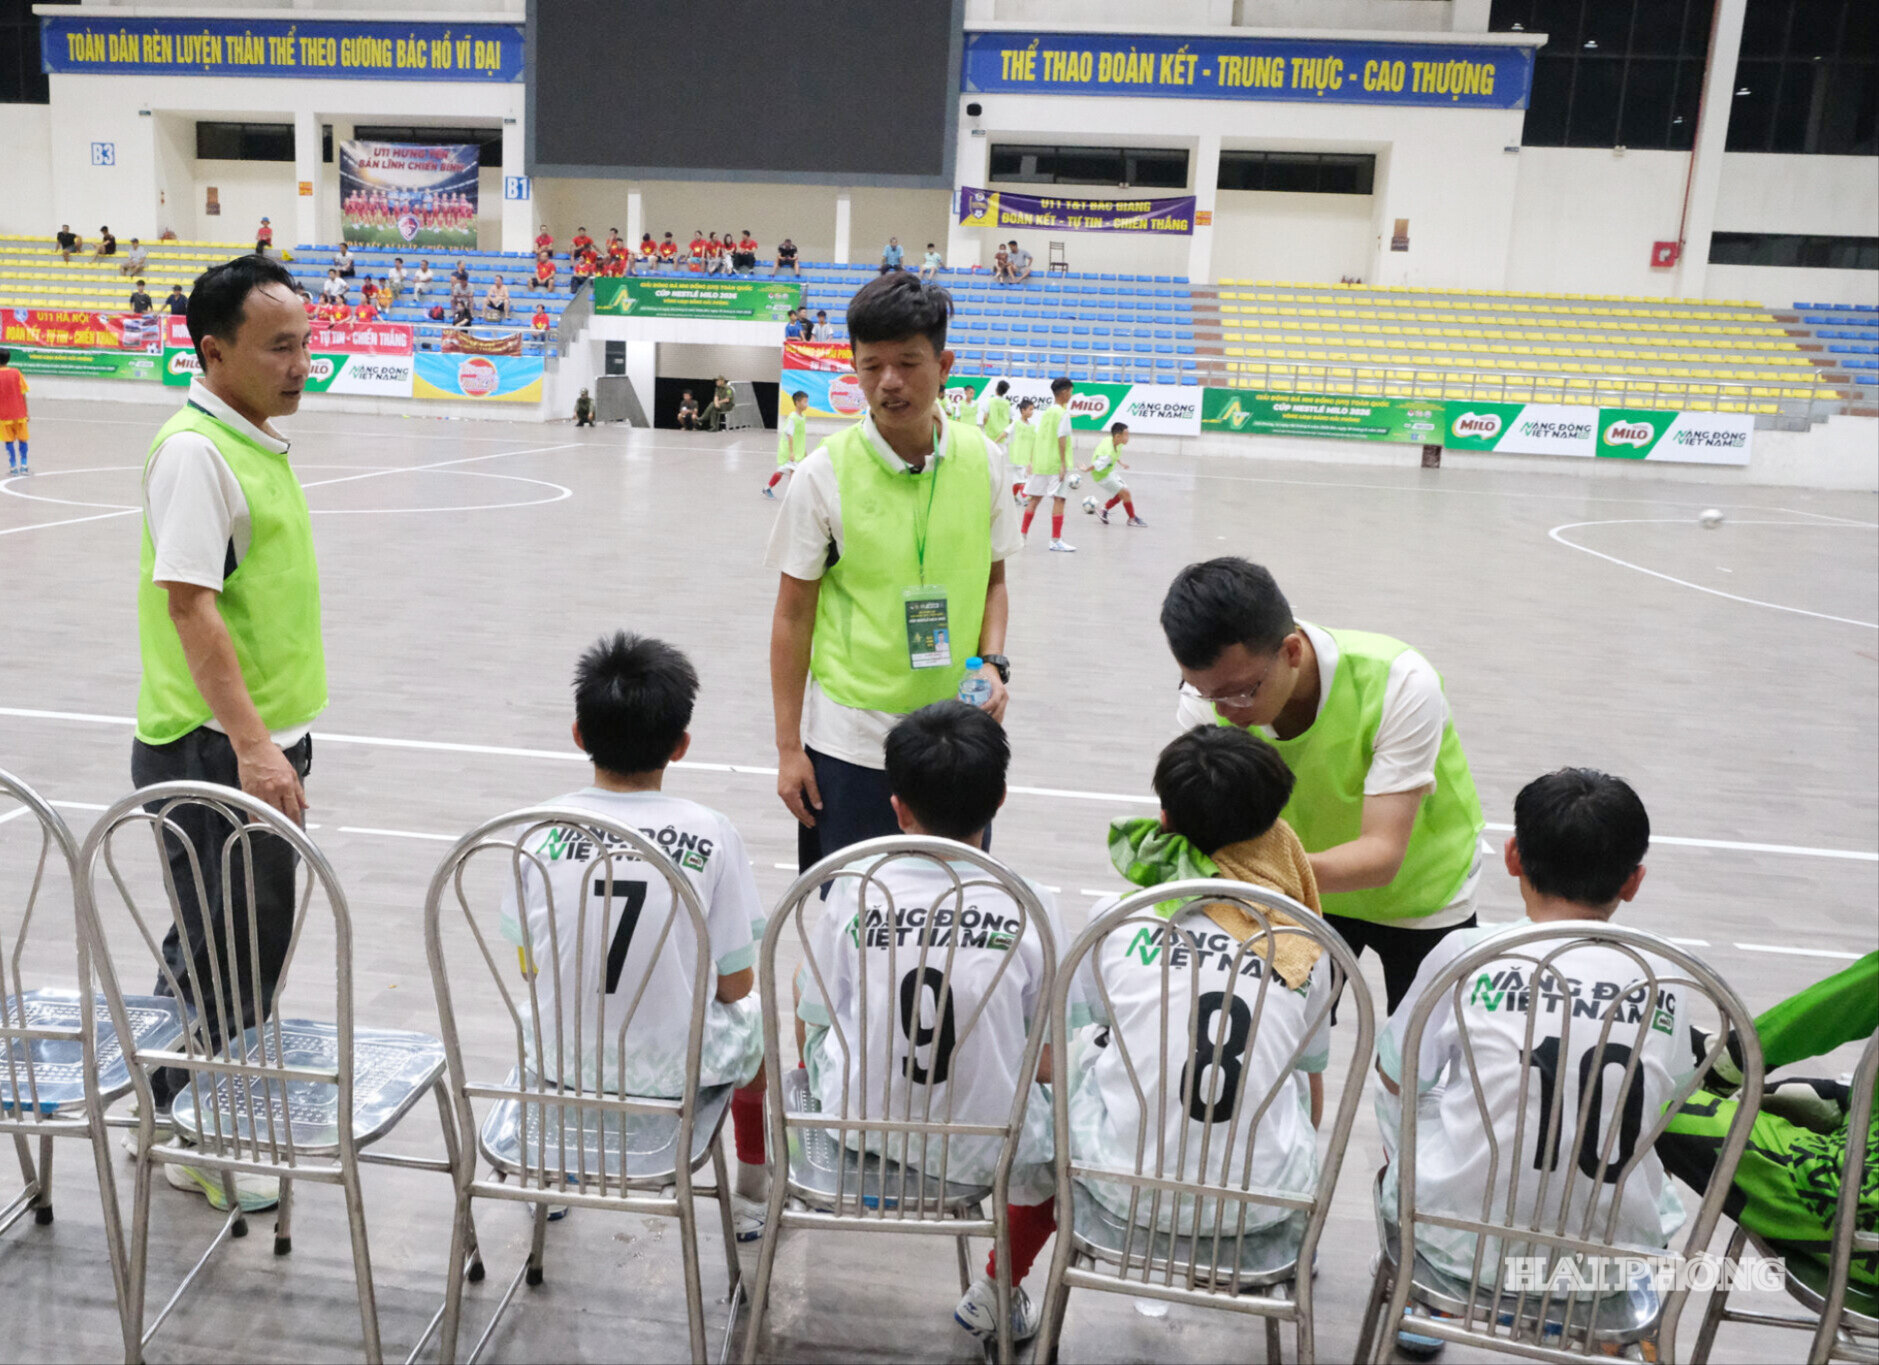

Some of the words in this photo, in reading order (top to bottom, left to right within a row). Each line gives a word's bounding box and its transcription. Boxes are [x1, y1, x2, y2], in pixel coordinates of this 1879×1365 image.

[67, 27, 106, 62] TOÀN
[109, 28, 139, 63] DÂN
[143, 28, 172, 63] RÈN
[176, 29, 222, 70] LUYỆN
[225, 30, 265, 65] THÂN
[268, 25, 296, 65] THỂ
[299, 37, 337, 66] THEO
[340, 35, 392, 67] GƯƠNG
[397, 33, 427, 68] BÁC
[456, 34, 471, 69] VĨ
[474, 40, 500, 76] ĐẠI
[1001, 38, 1039, 81] THỂ
[1042, 50, 1093, 83] THAO
[1098, 46, 1155, 83] ĐOÀN
[1159, 44, 1198, 85] KẾT
[1217, 55, 1285, 88] TRUNG
[1291, 55, 1344, 96] THỰC
[1363, 60, 1406, 92] CAO
[1412, 59, 1496, 101] THƯỢNG
[93, 143, 114, 165] B3
[507, 178, 528, 199] B1
[1084, 216, 1102, 228] TIN
[310, 365, 329, 375] ILO
[1070, 400, 1104, 412] MILO
[1460, 419, 1496, 432] MILO
[1611, 427, 1648, 440] MILO
[594, 879, 648, 994] 7
[1139, 943, 1214, 969] VỆT
[900, 967, 956, 1085] 9
[1180, 991, 1252, 1123] 8
[1519, 1036, 1644, 1184] 10
